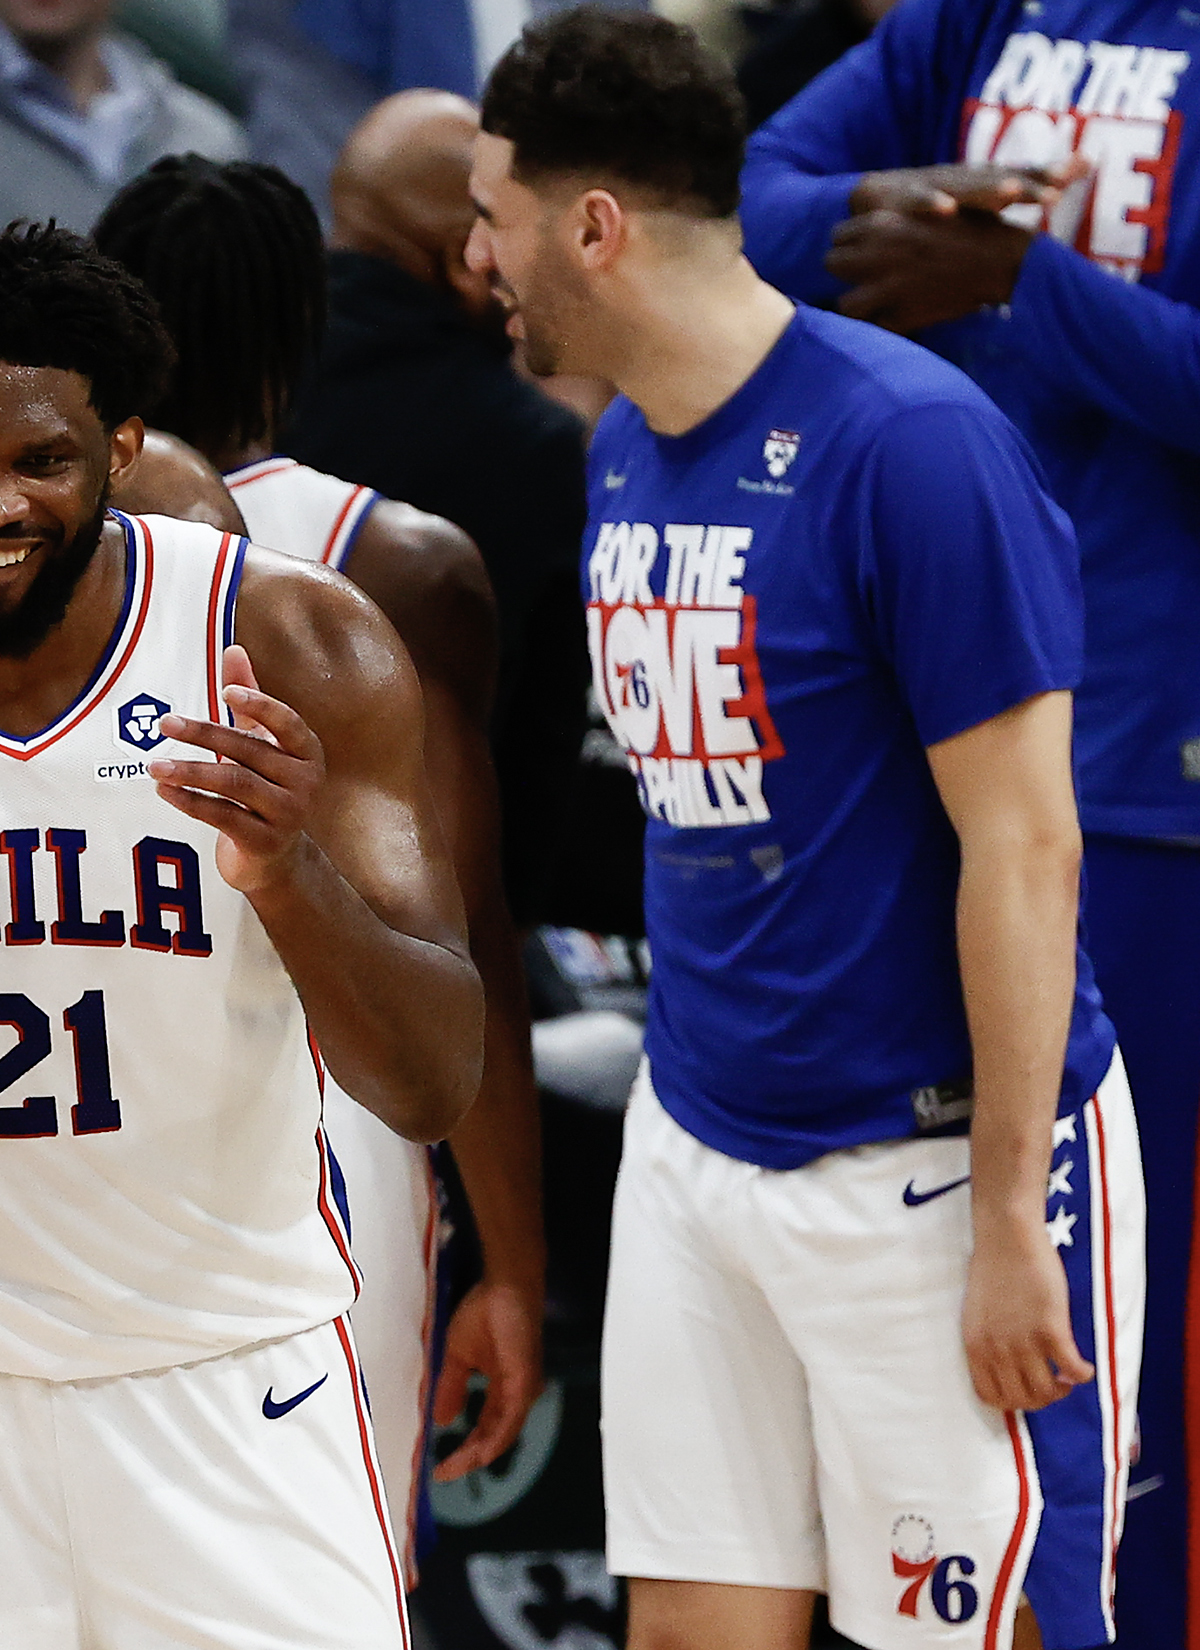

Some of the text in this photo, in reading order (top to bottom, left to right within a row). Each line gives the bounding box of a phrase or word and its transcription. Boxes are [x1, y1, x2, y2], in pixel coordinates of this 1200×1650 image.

[1074, 40, 1191, 122] THE
[589, 520, 754, 609] FOR THE
[614, 659, 650, 709] 76
[97, 761, 149, 779] crypt
[891, 1550, 978, 1624] 76
